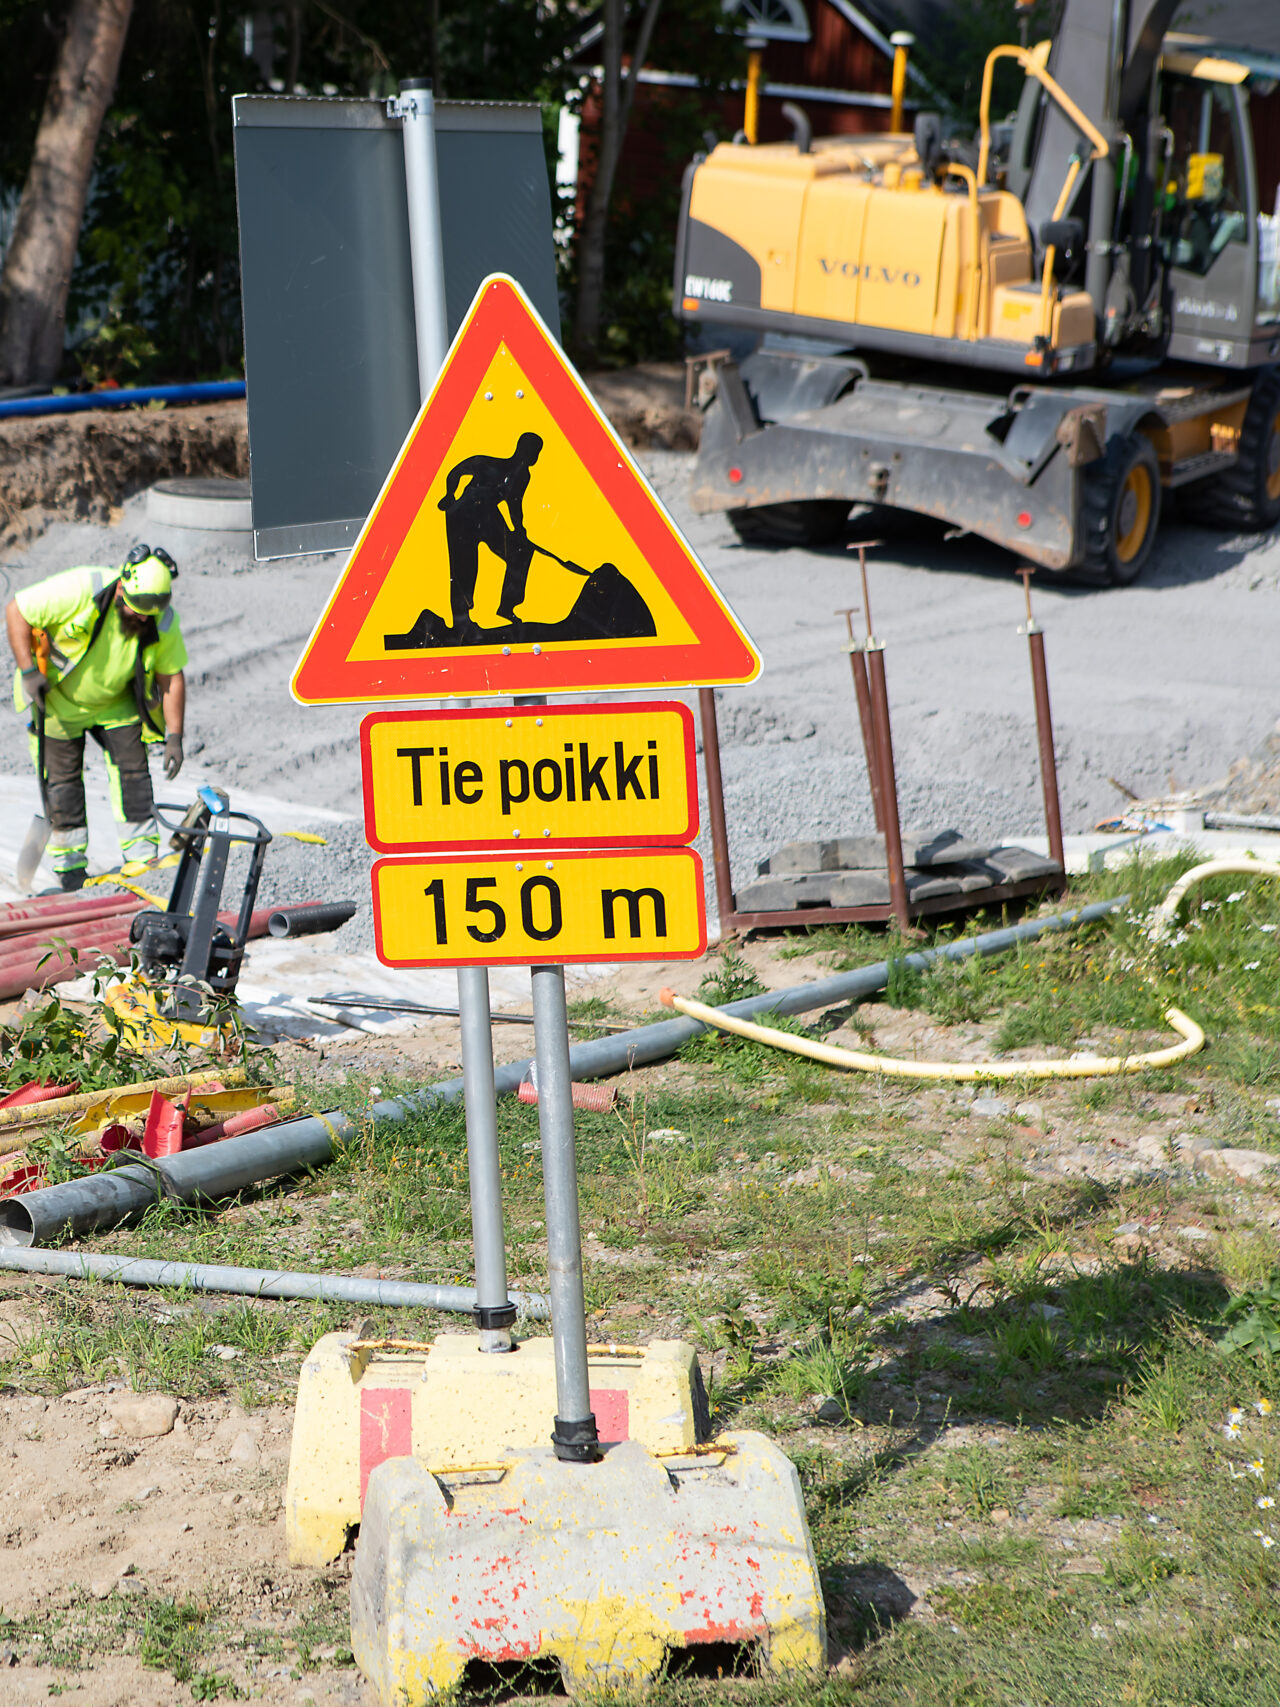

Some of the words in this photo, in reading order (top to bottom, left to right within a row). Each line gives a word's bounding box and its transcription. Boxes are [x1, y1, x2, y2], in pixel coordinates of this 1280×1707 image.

[818, 258, 921, 287] VOLVO
[397, 746, 484, 806] Tie
[500, 740, 661, 815] poikki
[424, 875, 563, 945] 150
[601, 887, 668, 939] m
